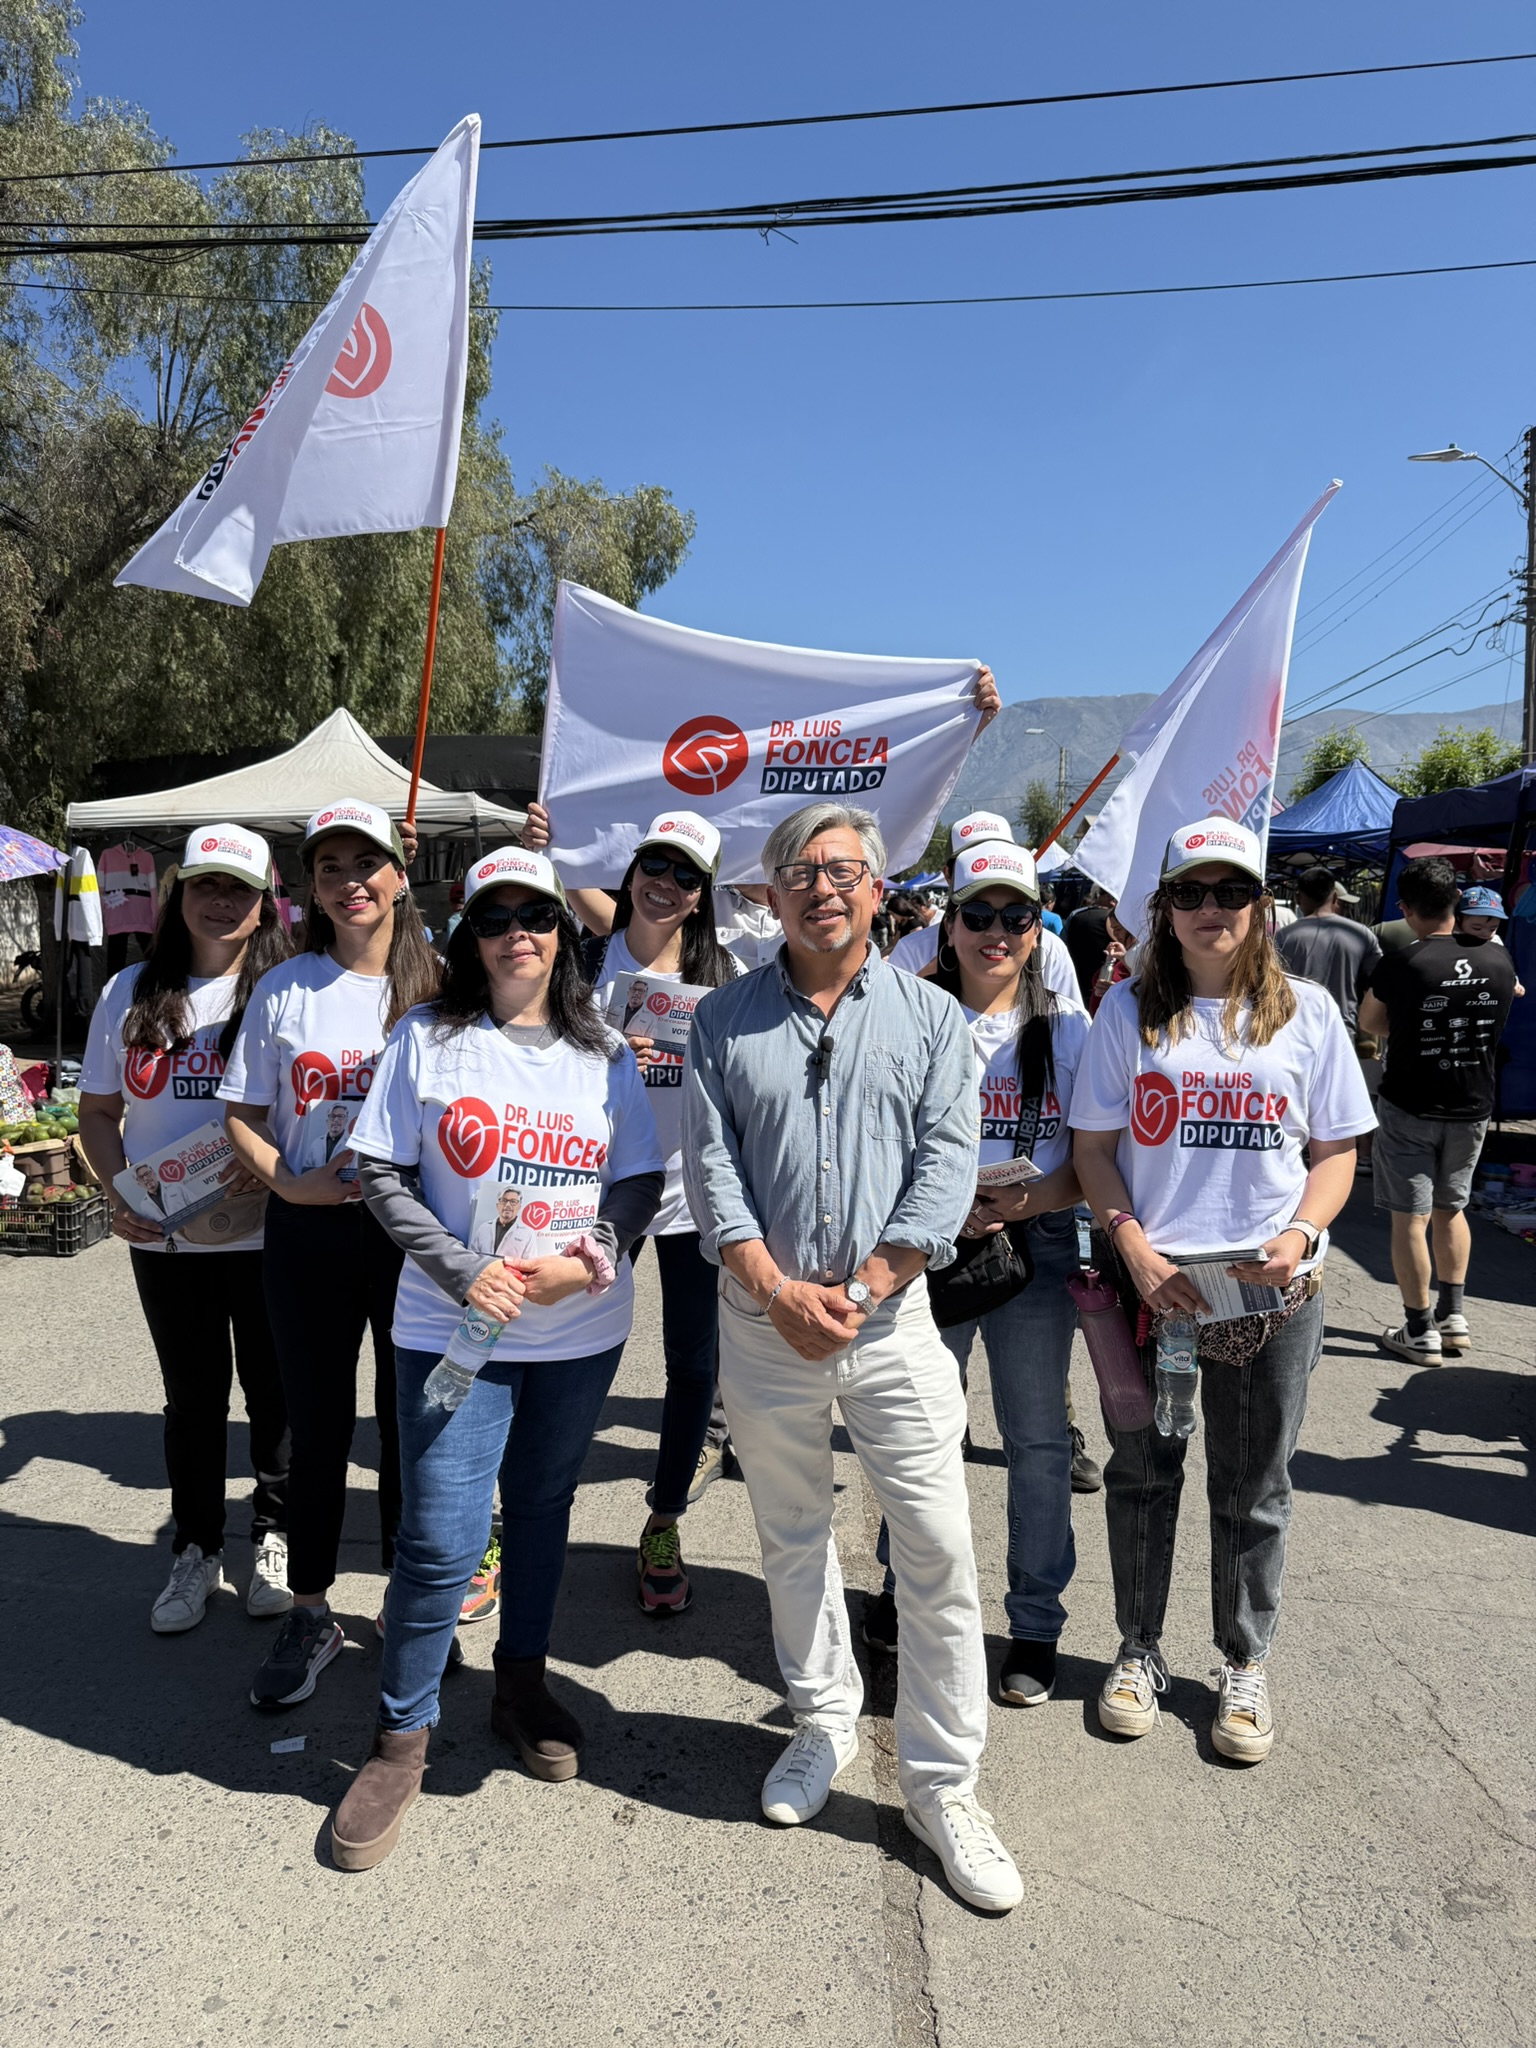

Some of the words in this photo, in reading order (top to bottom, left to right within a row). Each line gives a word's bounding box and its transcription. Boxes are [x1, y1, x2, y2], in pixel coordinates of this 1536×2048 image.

[769, 720, 797, 738] DR.
[803, 720, 842, 738] LUIS
[765, 736, 889, 766] FONCEA
[764, 770, 882, 792] DIPUTADO
[1440, 977, 1490, 987] SCOTT
[671, 1000, 695, 1012] FON
[1422, 1001, 1449, 1009] PAINE
[670, 1010, 692, 1020] DIPU
[204, 1038, 221, 1051] LU
[172, 1052, 227, 1075] FON
[341, 1049, 367, 1066] DR.
[341, 1068, 375, 1094] FO
[987, 1076, 1017, 1091] LUIS
[1182, 1071, 1209, 1089] DR.
[1214, 1072, 1253, 1089] LUIS
[1181, 1090, 1288, 1121] FONCEA
[504, 1103, 532, 1127] DR.
[537, 1110, 574, 1133] LUIS
[1183, 1124, 1284, 1148] DIPUTADO
[181, 1136, 229, 1167] FONCEA
[500, 1123, 607, 1169] FONCEA
[188, 1145, 232, 1174] DIPUTADO
[551, 1204, 595, 1219] FONCEA
[566, 1199, 580, 1207] LUIS
[551, 1217, 594, 1230] DIPUTADO
[554, 1240, 570, 1250] VO
[471, 1324, 488, 1336] vital
